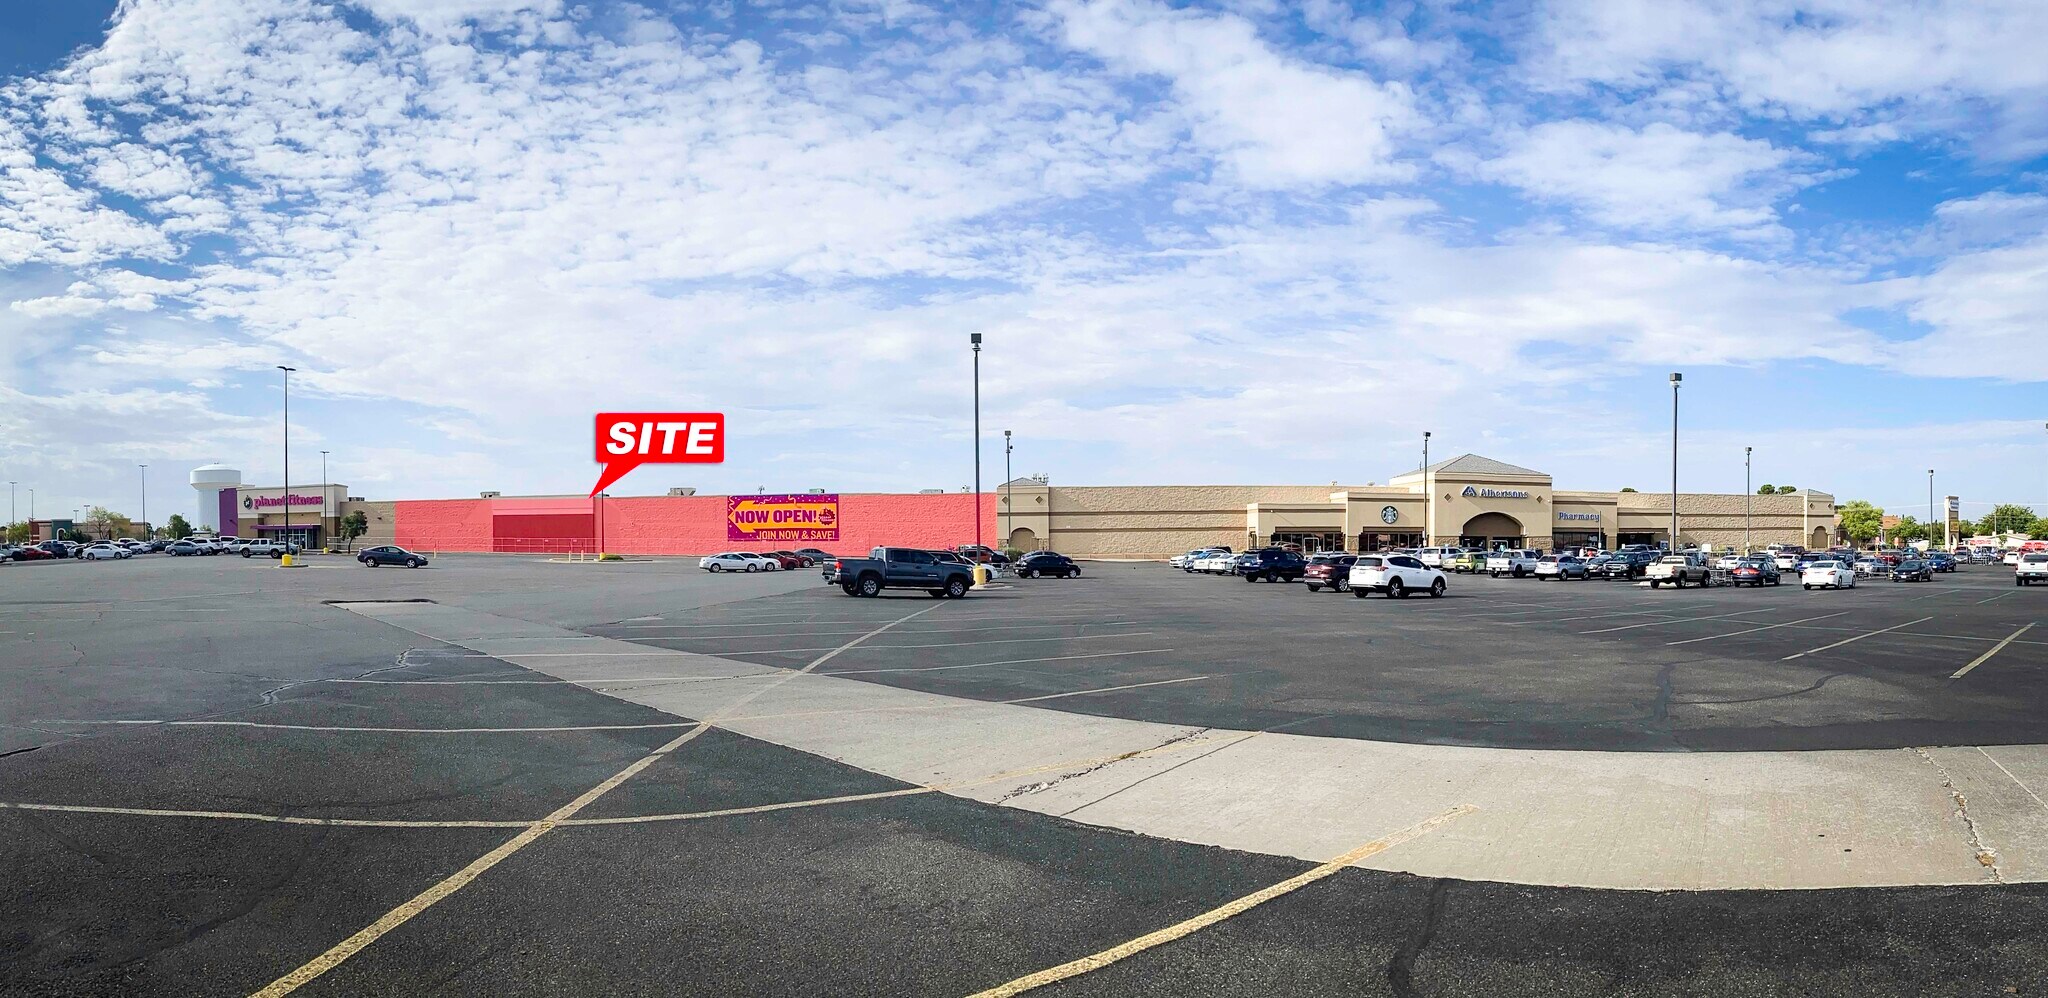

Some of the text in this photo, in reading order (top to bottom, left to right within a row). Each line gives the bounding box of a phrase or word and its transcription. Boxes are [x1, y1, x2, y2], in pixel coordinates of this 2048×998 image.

[1480, 488, 1529, 499] Albertsons
[254, 494, 323, 509] planet fitness
[735, 510, 769, 524] NOW
[773, 510, 817, 523] OPEN!
[1557, 511, 1600, 523] Pharmacy
[757, 530, 835, 540] JOIN NOW & SAVE!
